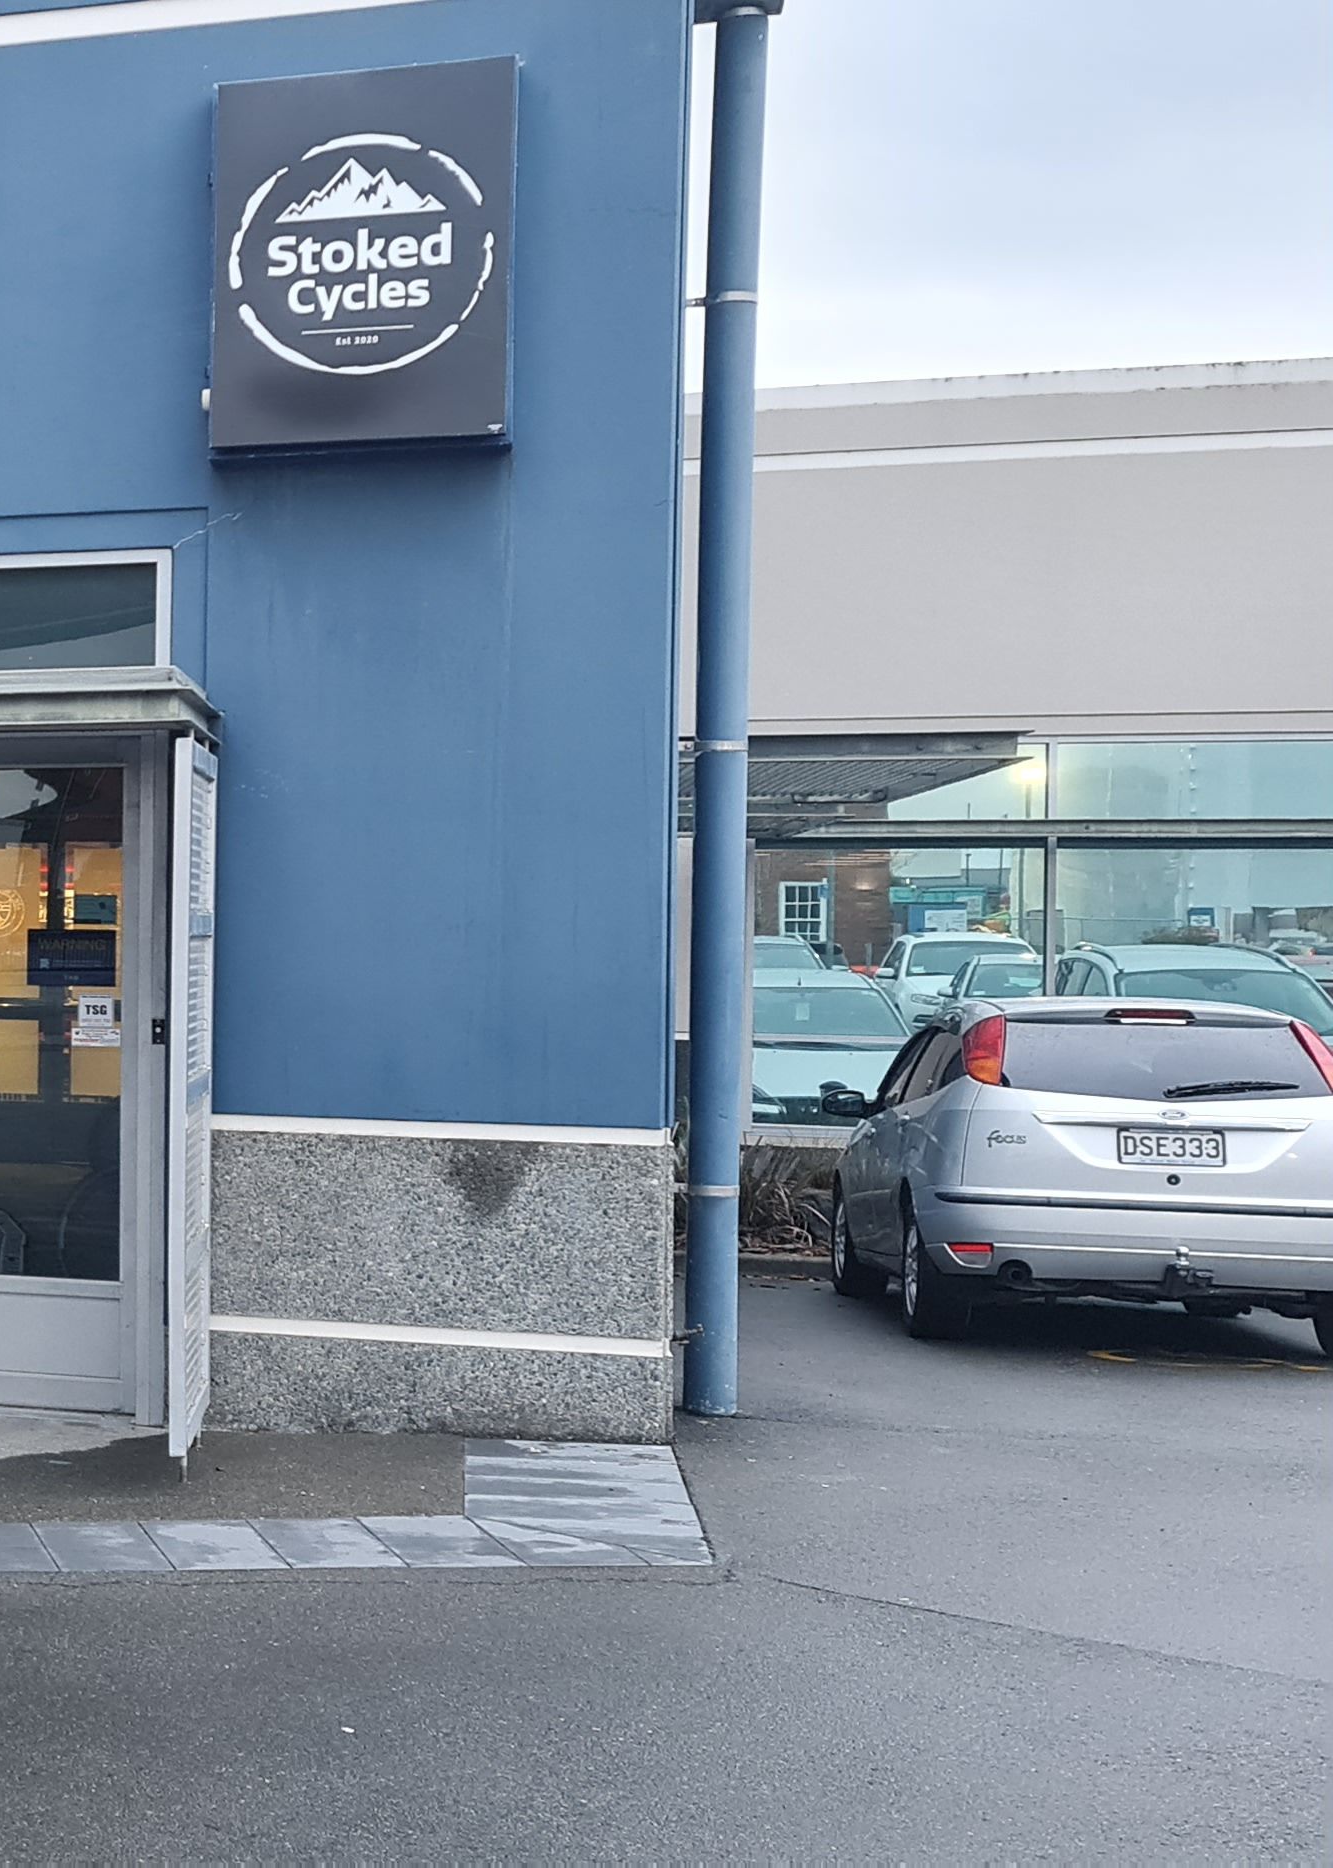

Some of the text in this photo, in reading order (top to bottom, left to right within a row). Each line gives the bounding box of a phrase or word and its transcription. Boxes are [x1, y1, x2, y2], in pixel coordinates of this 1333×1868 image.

[267, 222, 453, 277] Stoked
[287, 273, 431, 321] Cycles
[335, 334, 379, 346] Est 2020
[37, 937, 108, 950] WARNING
[84, 1004, 108, 1016] TSG
[1123, 1135, 1221, 1159] DSE333
